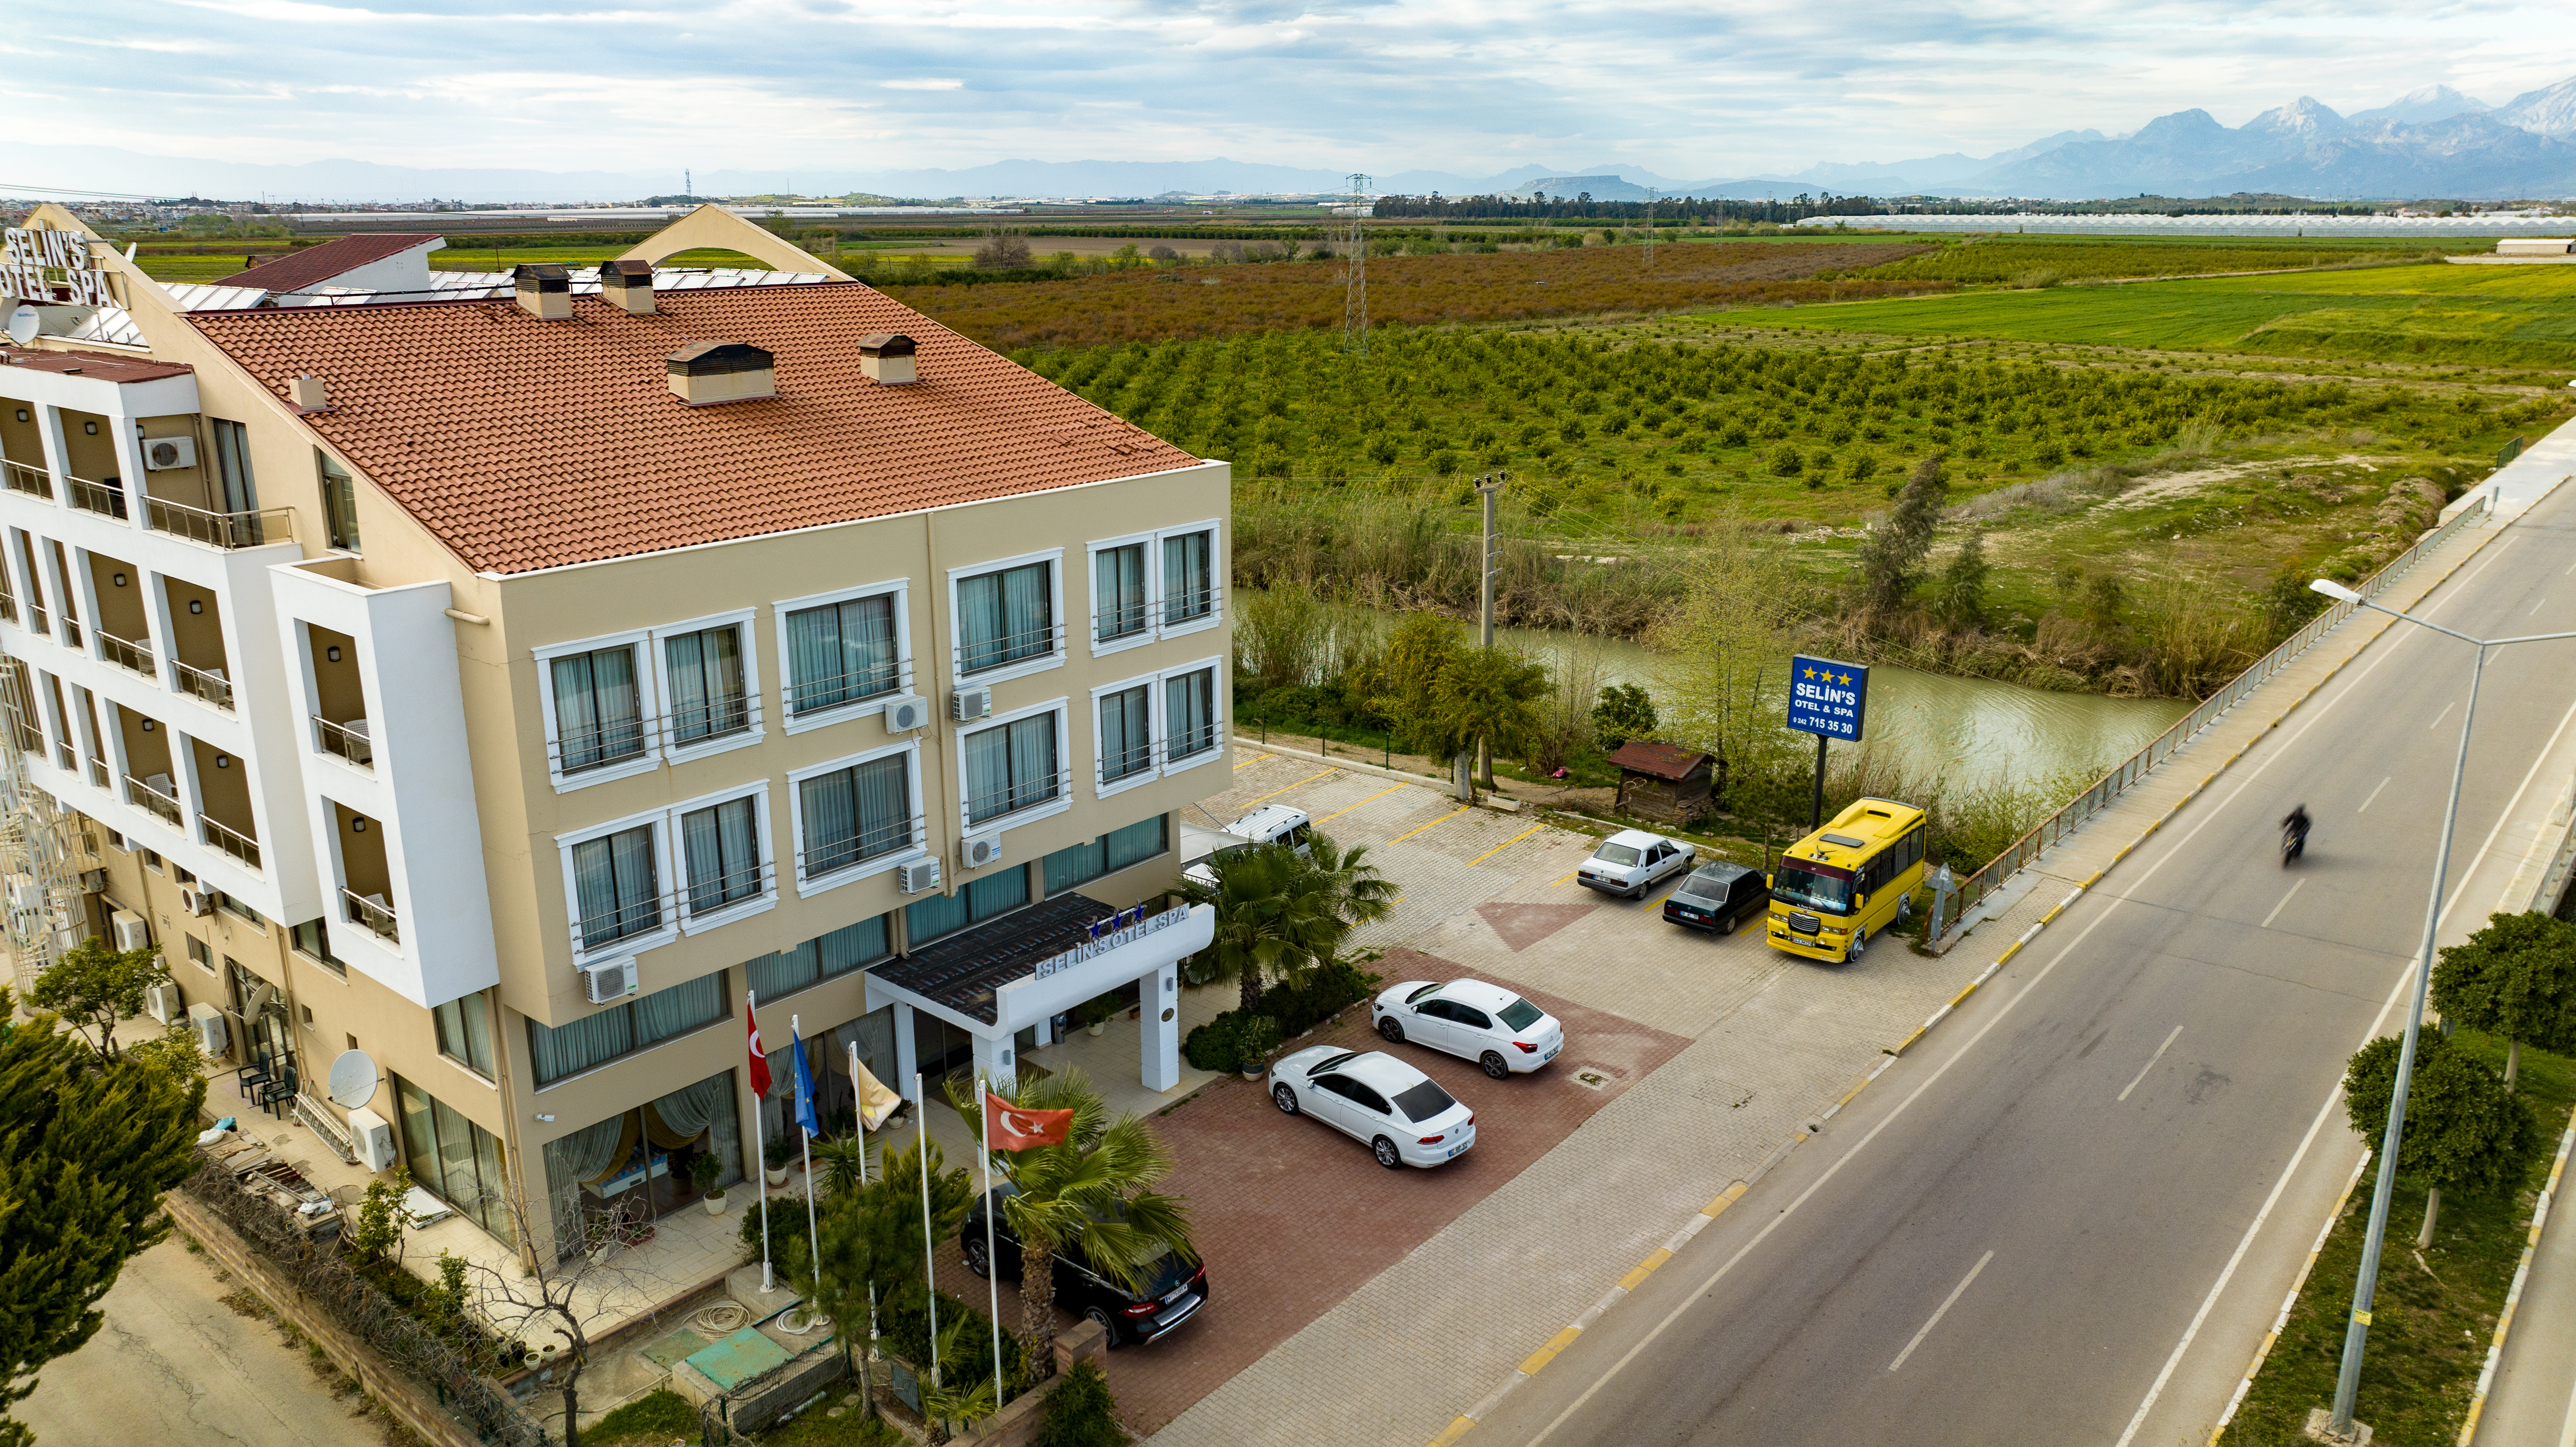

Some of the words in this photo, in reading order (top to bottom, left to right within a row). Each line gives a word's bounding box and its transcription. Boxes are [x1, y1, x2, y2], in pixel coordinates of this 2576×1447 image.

[0, 264, 54, 302] OTEL
[66, 269, 112, 308] SPA
[1796, 683, 1855, 705] SELİN'S
[1795, 700, 1820, 711] OTEL
[1834, 707, 1853, 717] SPA
[1809, 717, 1825, 728] 715
[1827, 720, 1839, 731] 35
[1841, 723, 1852, 734] 30
[1111, 920, 1154, 947] OTEL
[1156, 906, 1188, 929] SPA
